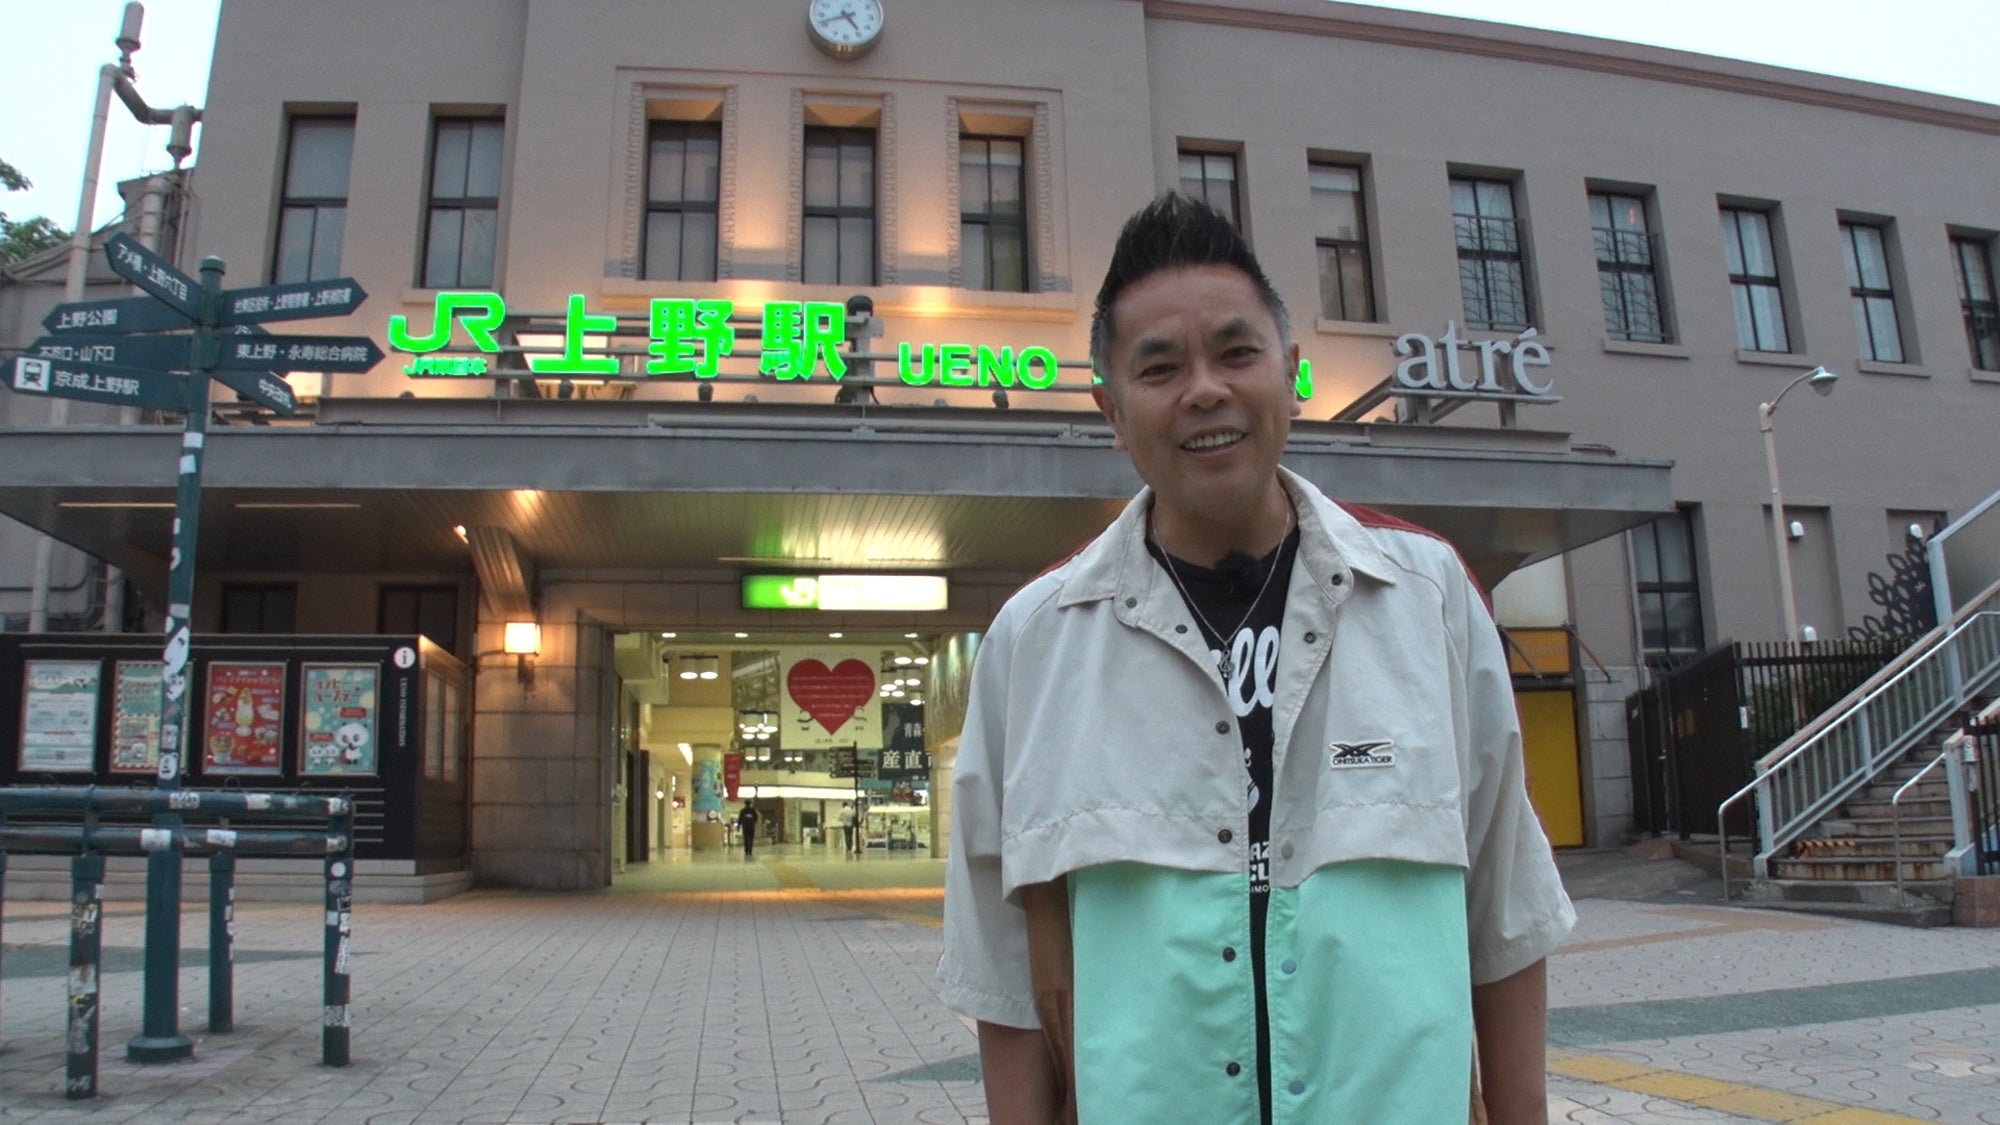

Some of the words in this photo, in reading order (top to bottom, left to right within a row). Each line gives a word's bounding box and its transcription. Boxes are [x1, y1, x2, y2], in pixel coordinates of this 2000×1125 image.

[56, 308, 118, 329] 上野公園
[388, 292, 506, 352] JR
[531, 294, 847, 380] 上野駅
[898, 342, 1058, 390] UENO
[1397, 320, 1554, 395] atré
[54, 370, 140, 395] 京成上野駅
